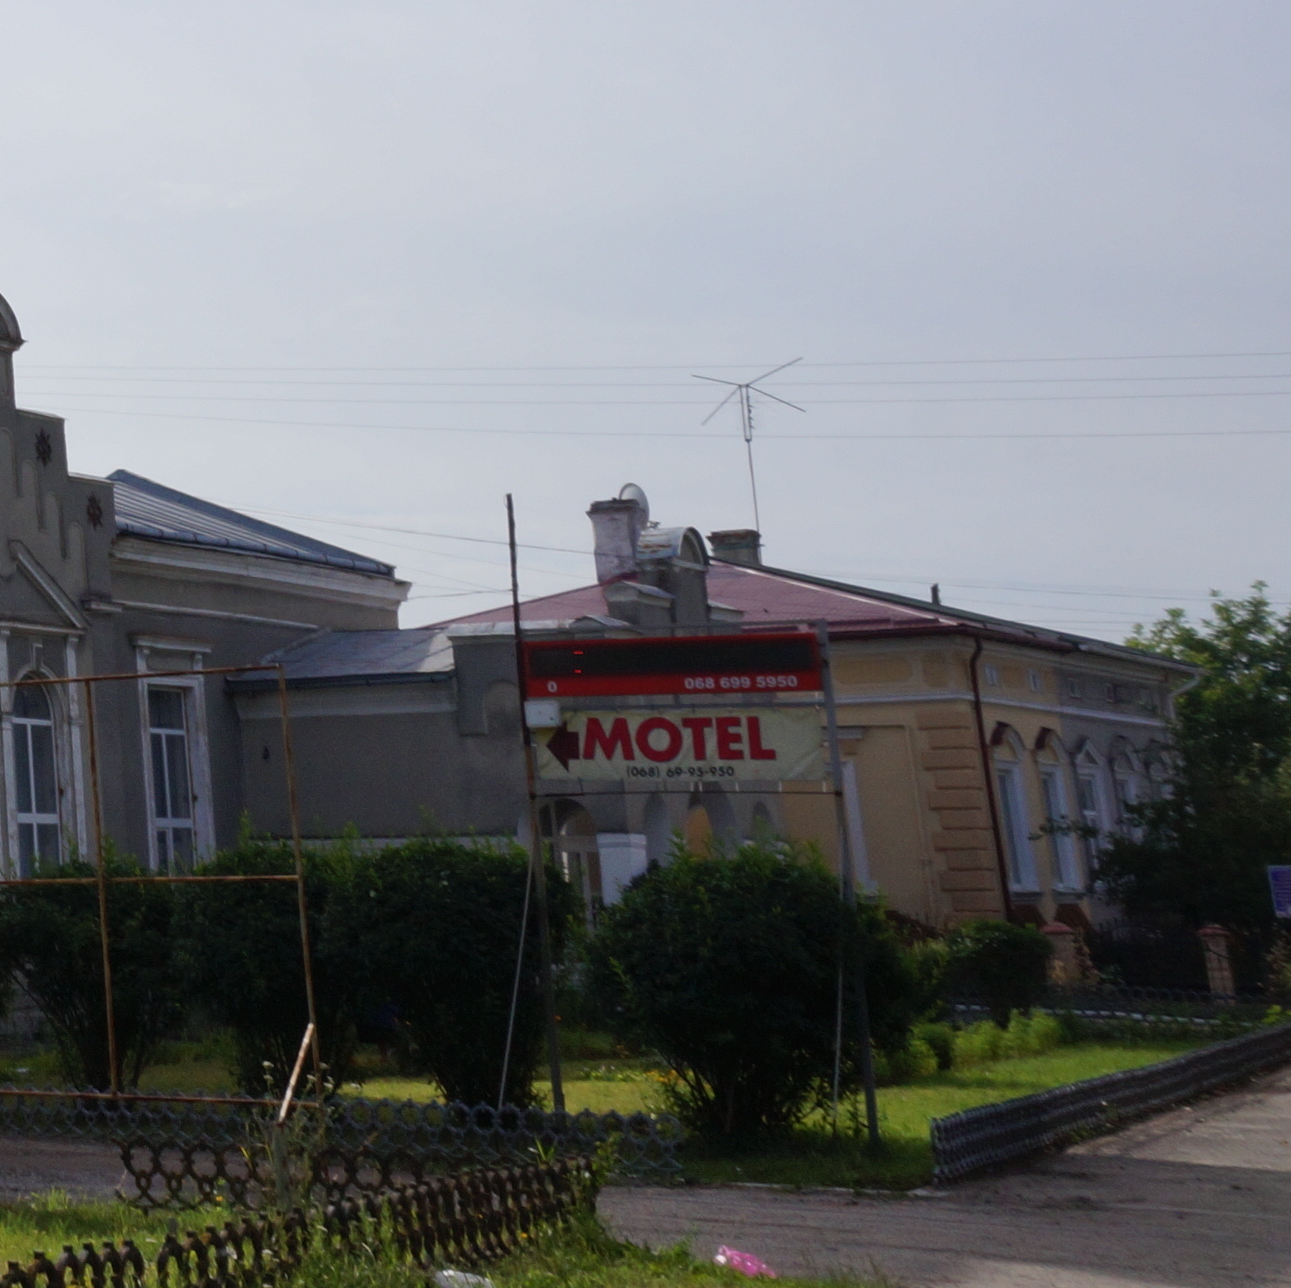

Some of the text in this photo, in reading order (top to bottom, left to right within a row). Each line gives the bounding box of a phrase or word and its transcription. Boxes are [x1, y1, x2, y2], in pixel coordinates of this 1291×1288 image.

[684, 675, 798, 690] 068 699 5950
[582, 716, 777, 763] MOTEL
[626, 765, 660, 779] (068)
